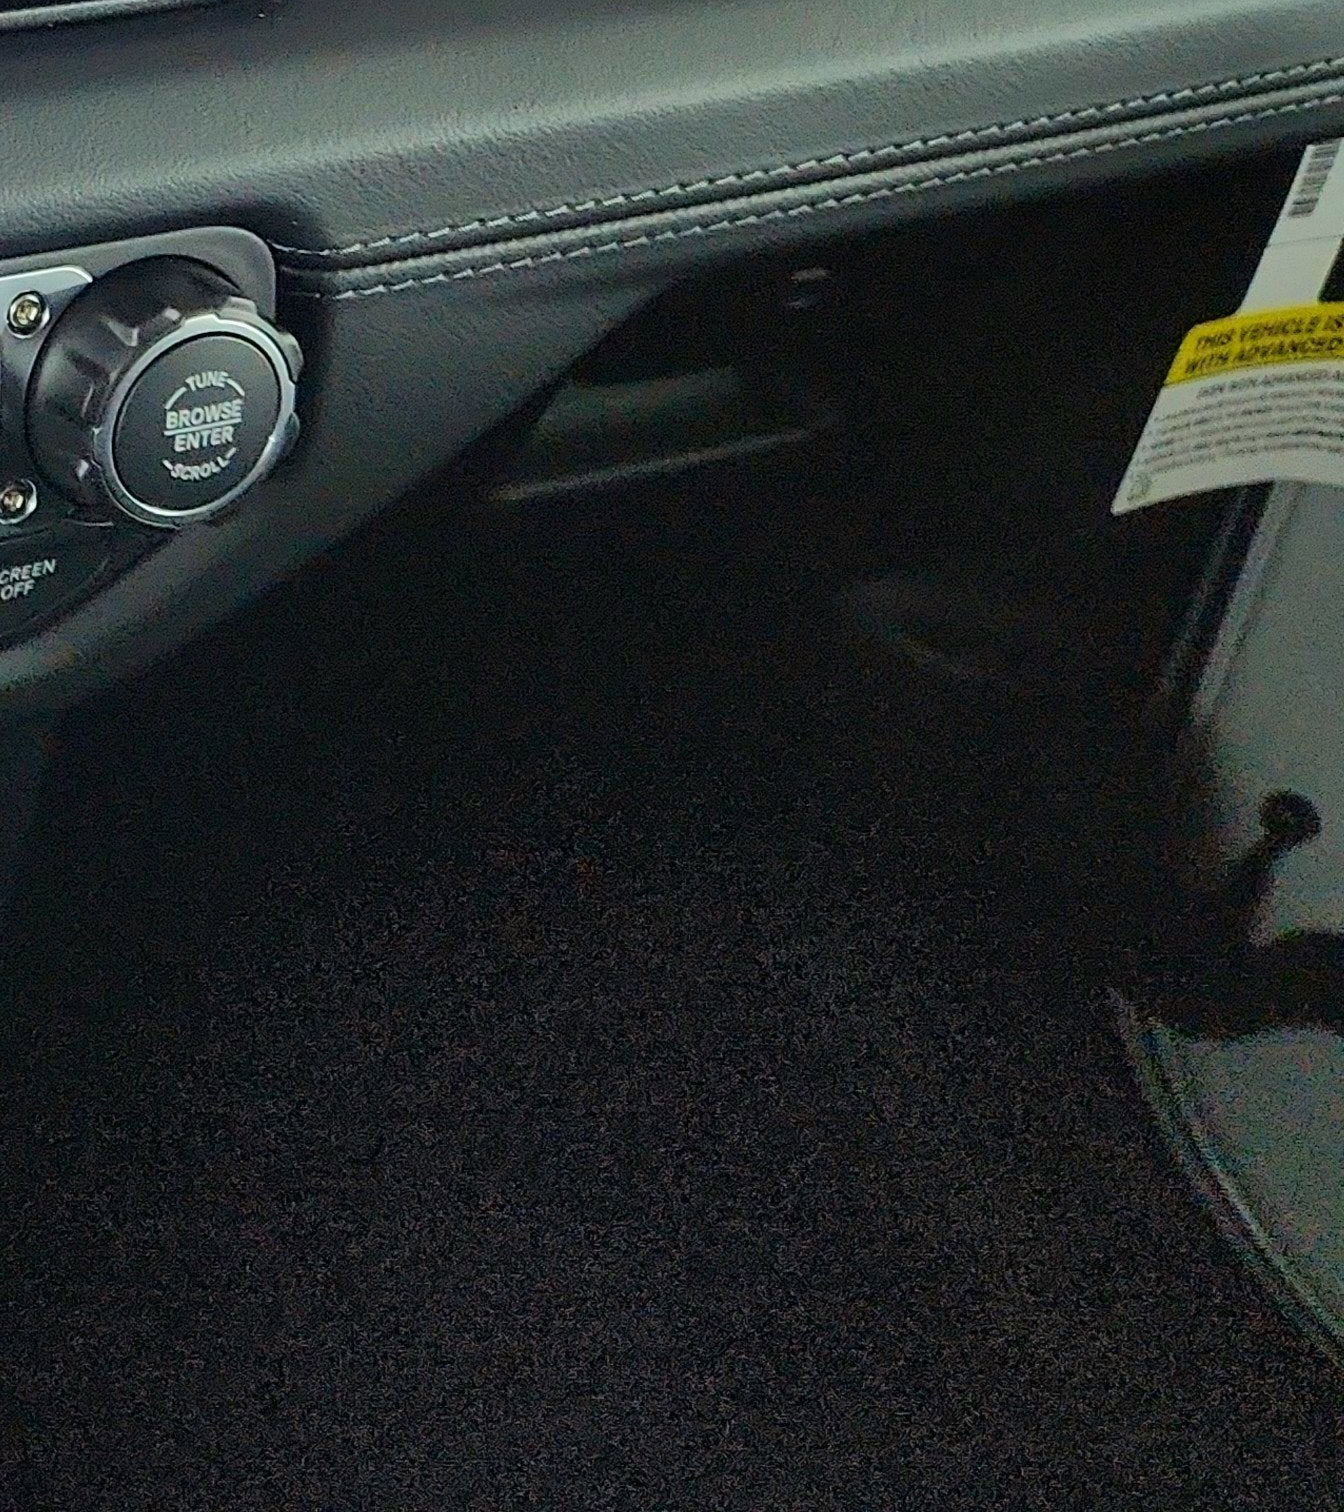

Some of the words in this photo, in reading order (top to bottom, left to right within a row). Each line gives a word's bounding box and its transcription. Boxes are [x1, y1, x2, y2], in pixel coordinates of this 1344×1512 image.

[185, 370, 229, 392] TUNE
[166, 398, 244, 430] BROWSE
[174, 425, 234, 453] ENTER
[170, 455, 231, 481] SCROLL
[0, 579, 35, 600] OFF
